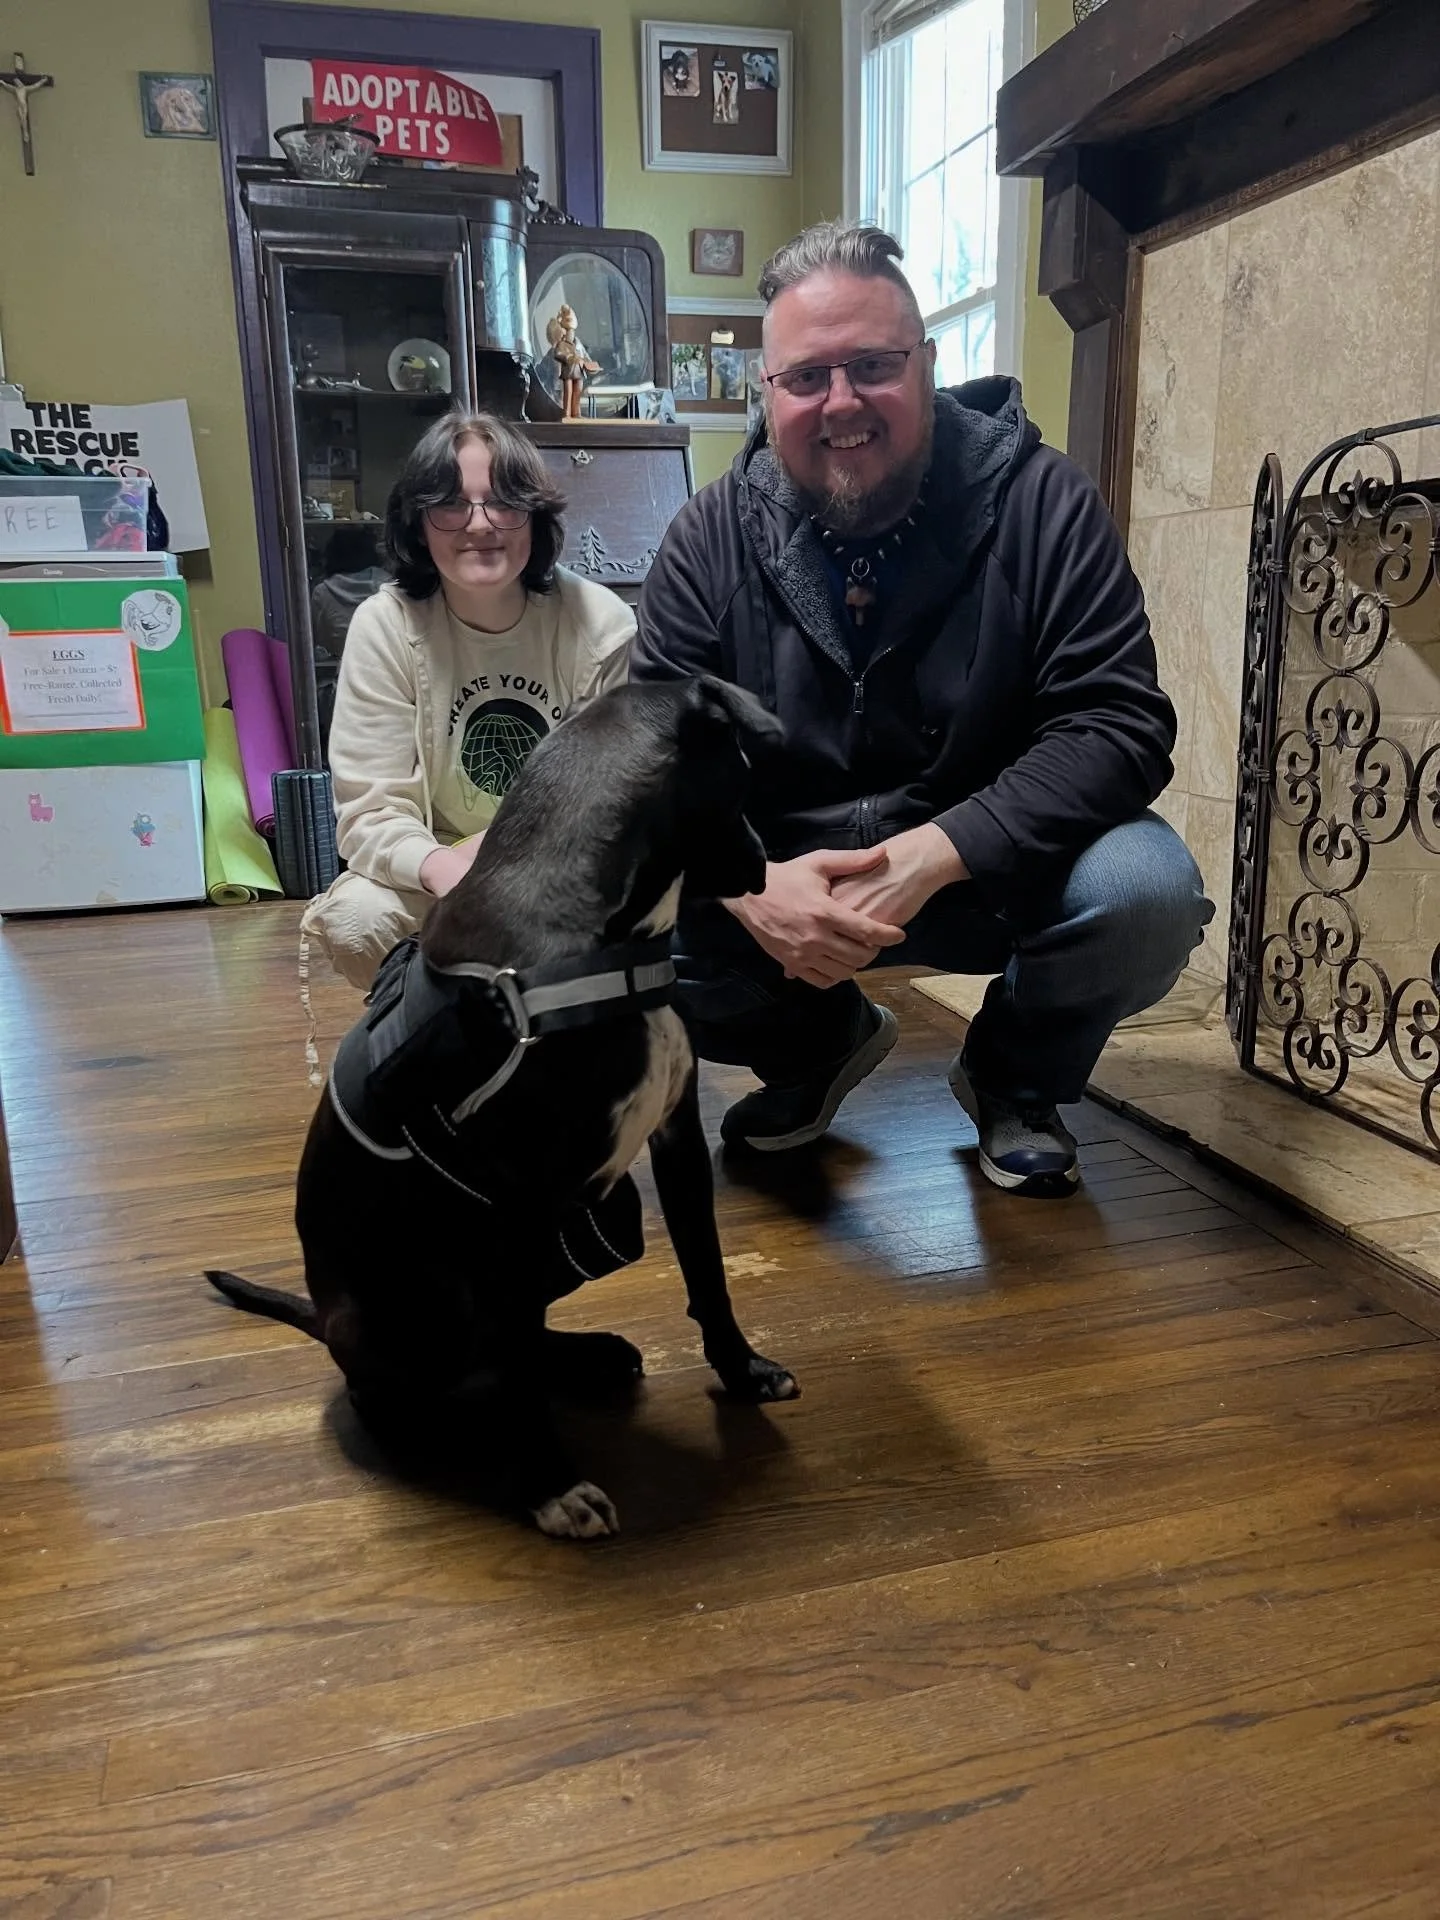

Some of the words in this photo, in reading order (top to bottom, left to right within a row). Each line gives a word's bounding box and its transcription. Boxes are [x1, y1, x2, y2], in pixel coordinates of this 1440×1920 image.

[323, 73, 489, 121] ADOPTABLE
[376, 115, 450, 154] PETS
[25, 402, 92, 429] THE
[10, 428, 140, 457] RESCUE
[52, 649, 85, 660] EGGS
[24, 667, 38, 676] For
[42, 666, 59, 675] Sale
[80, 678, 122, 689] Collected
[48, 694, 74, 704] Fresh
[499, 674, 549, 705] YOUR
